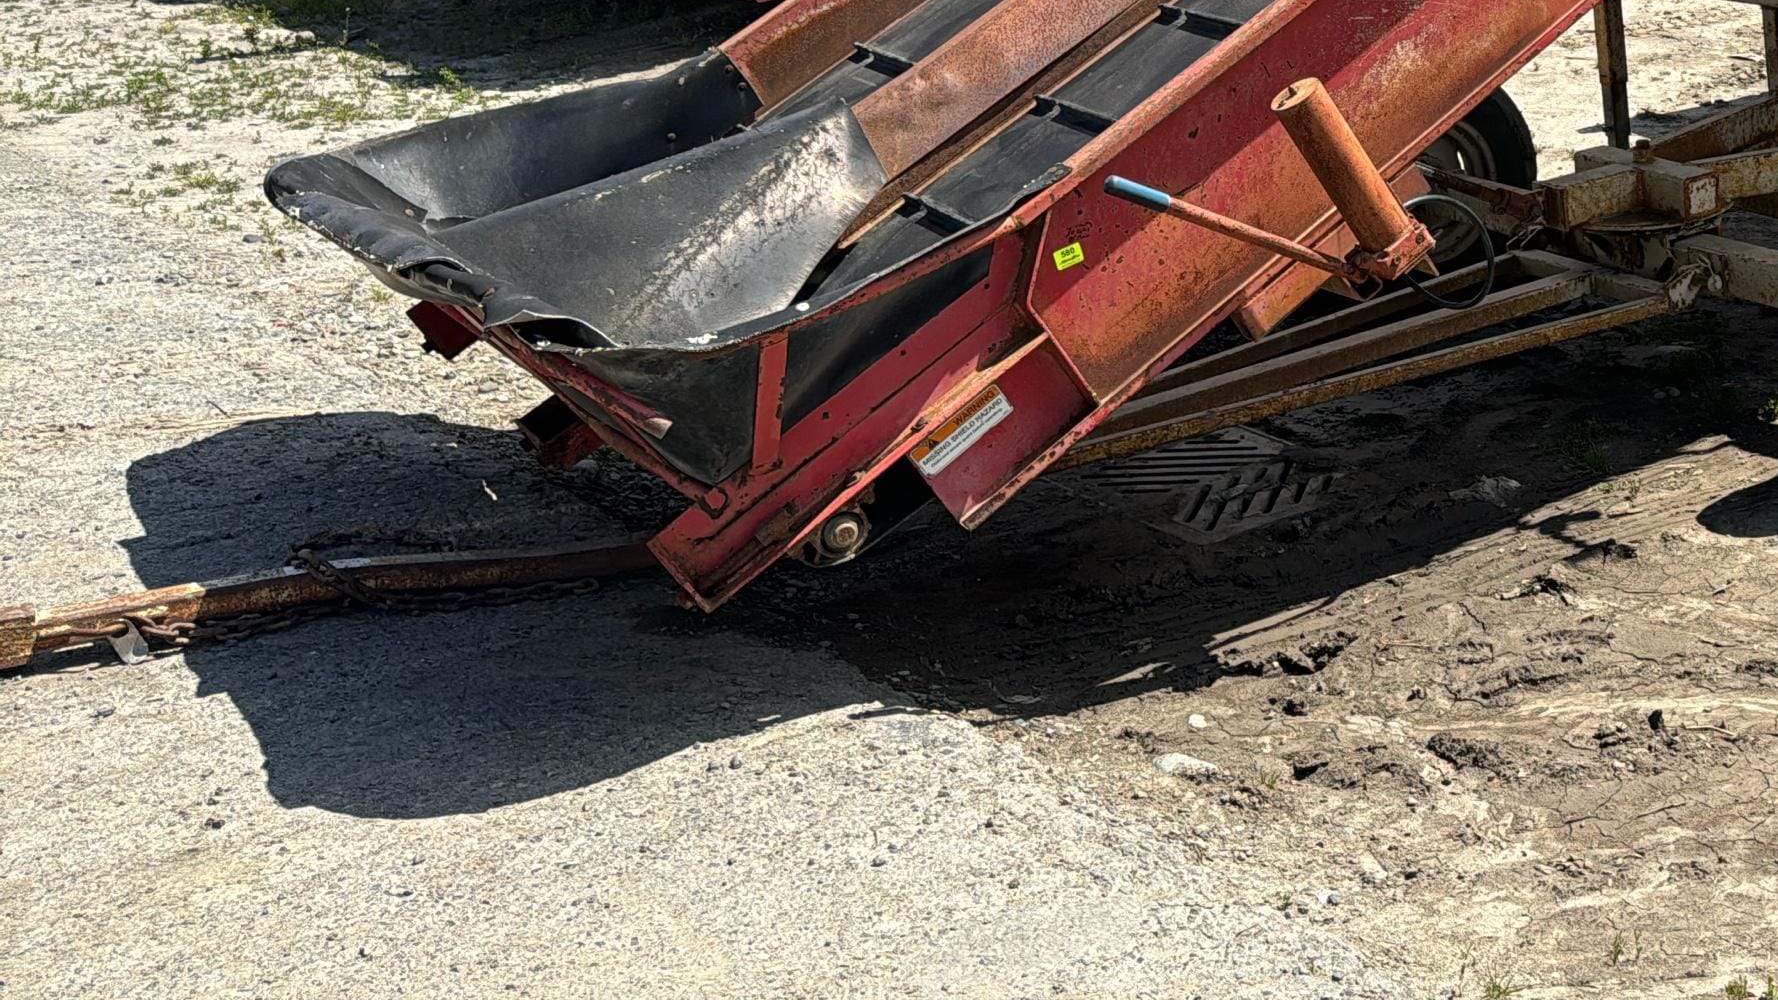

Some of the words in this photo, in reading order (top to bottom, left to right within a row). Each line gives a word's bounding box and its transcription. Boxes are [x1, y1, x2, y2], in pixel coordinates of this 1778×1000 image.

[922, 439, 952, 467] MISSING
[950, 420, 976, 443] SHIELD
[975, 397, 1004, 422] HAZARD
[952, 389, 996, 427] WARNING
